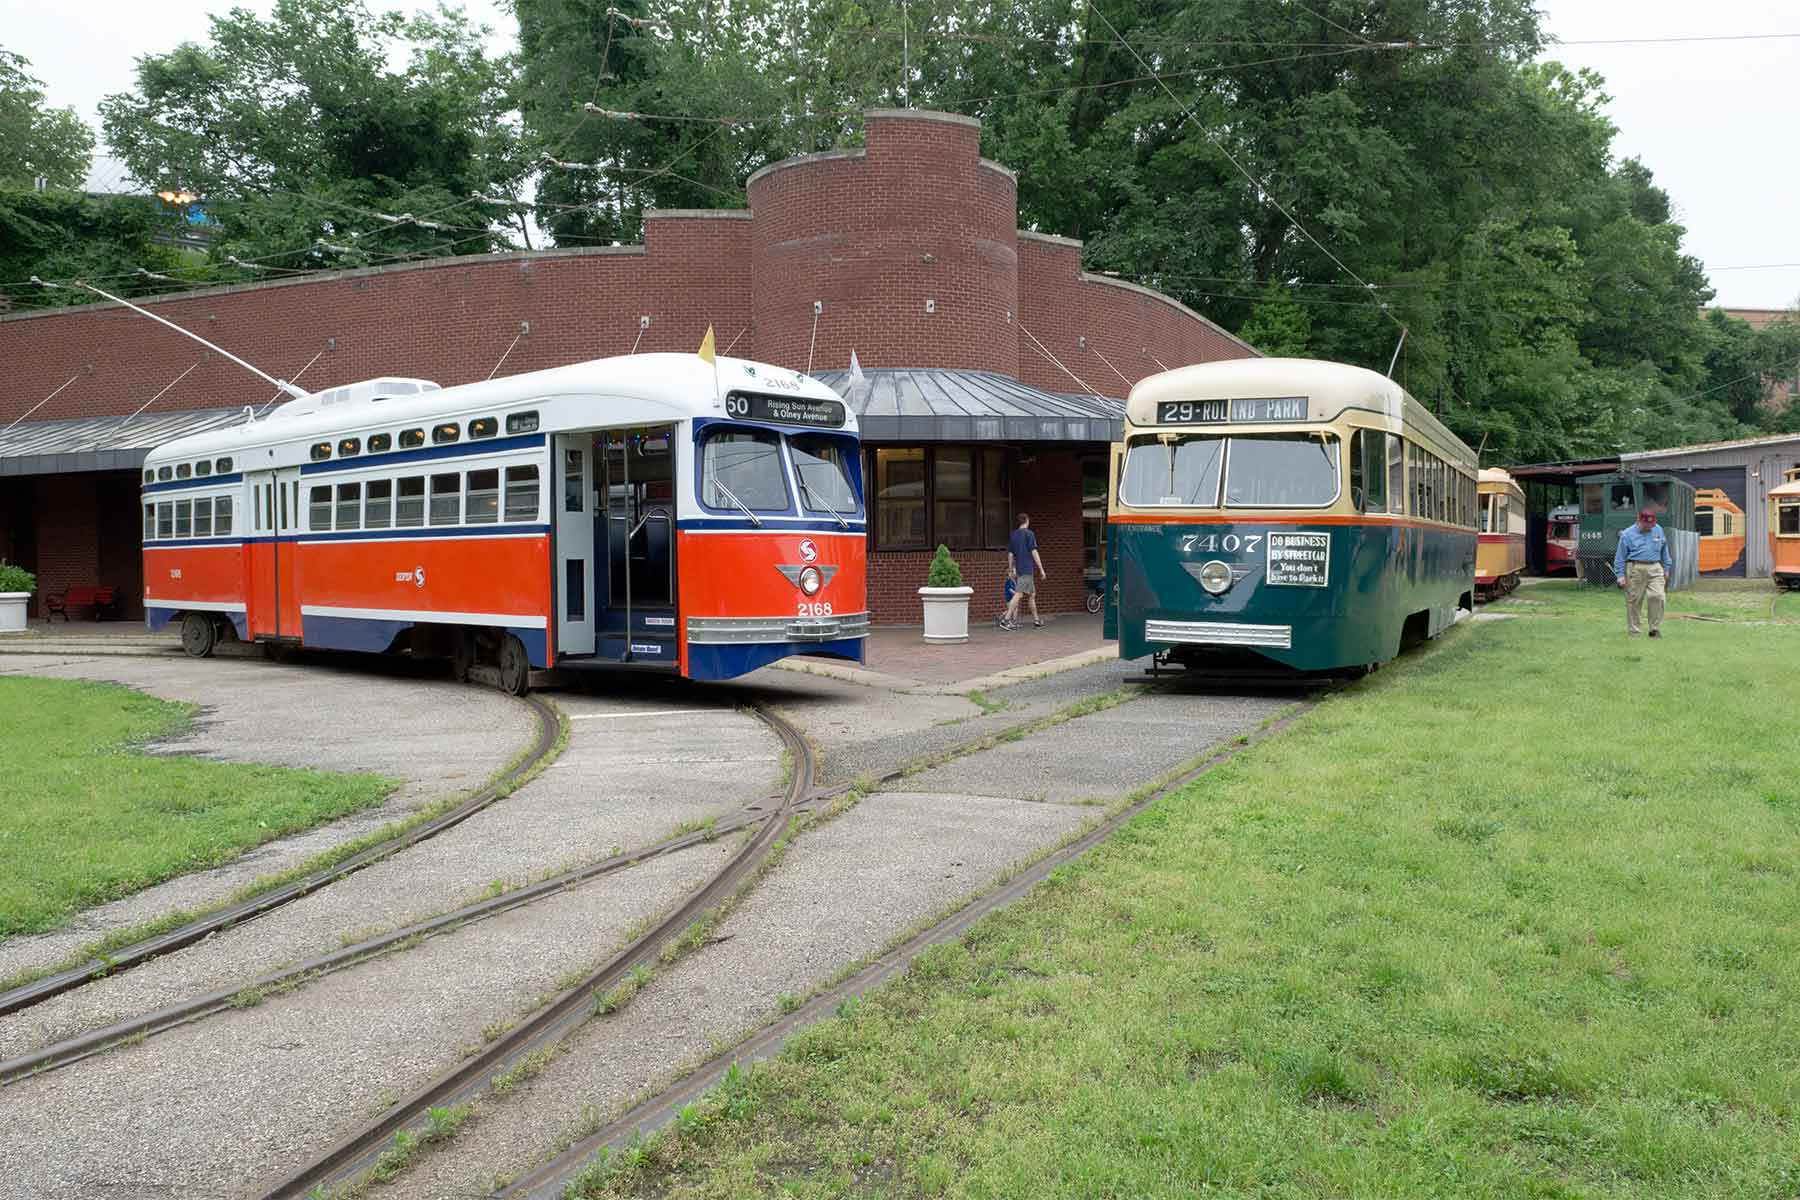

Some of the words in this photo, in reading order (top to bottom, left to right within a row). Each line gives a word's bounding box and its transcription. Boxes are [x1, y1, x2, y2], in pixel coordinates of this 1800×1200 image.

[766, 379, 801, 391] 2168
[727, 396, 749, 414] 50
[768, 400, 790, 411] Rising
[792, 402, 806, 411] Sun
[1267, 399, 1301, 419] PARK
[773, 410, 779, 418] &
[780, 410, 801, 420] Olney
[803, 412, 828, 421] Avenue
[1182, 534, 1265, 553] 7407
[1272, 536, 1284, 546] DO
[1285, 536, 1327, 547] BUSINESS
[1271, 550, 1282, 560] BY
[1280, 563, 1296, 572] You
[1289, 574, 1298, 582] to
[798, 602, 832, 616] 2168
